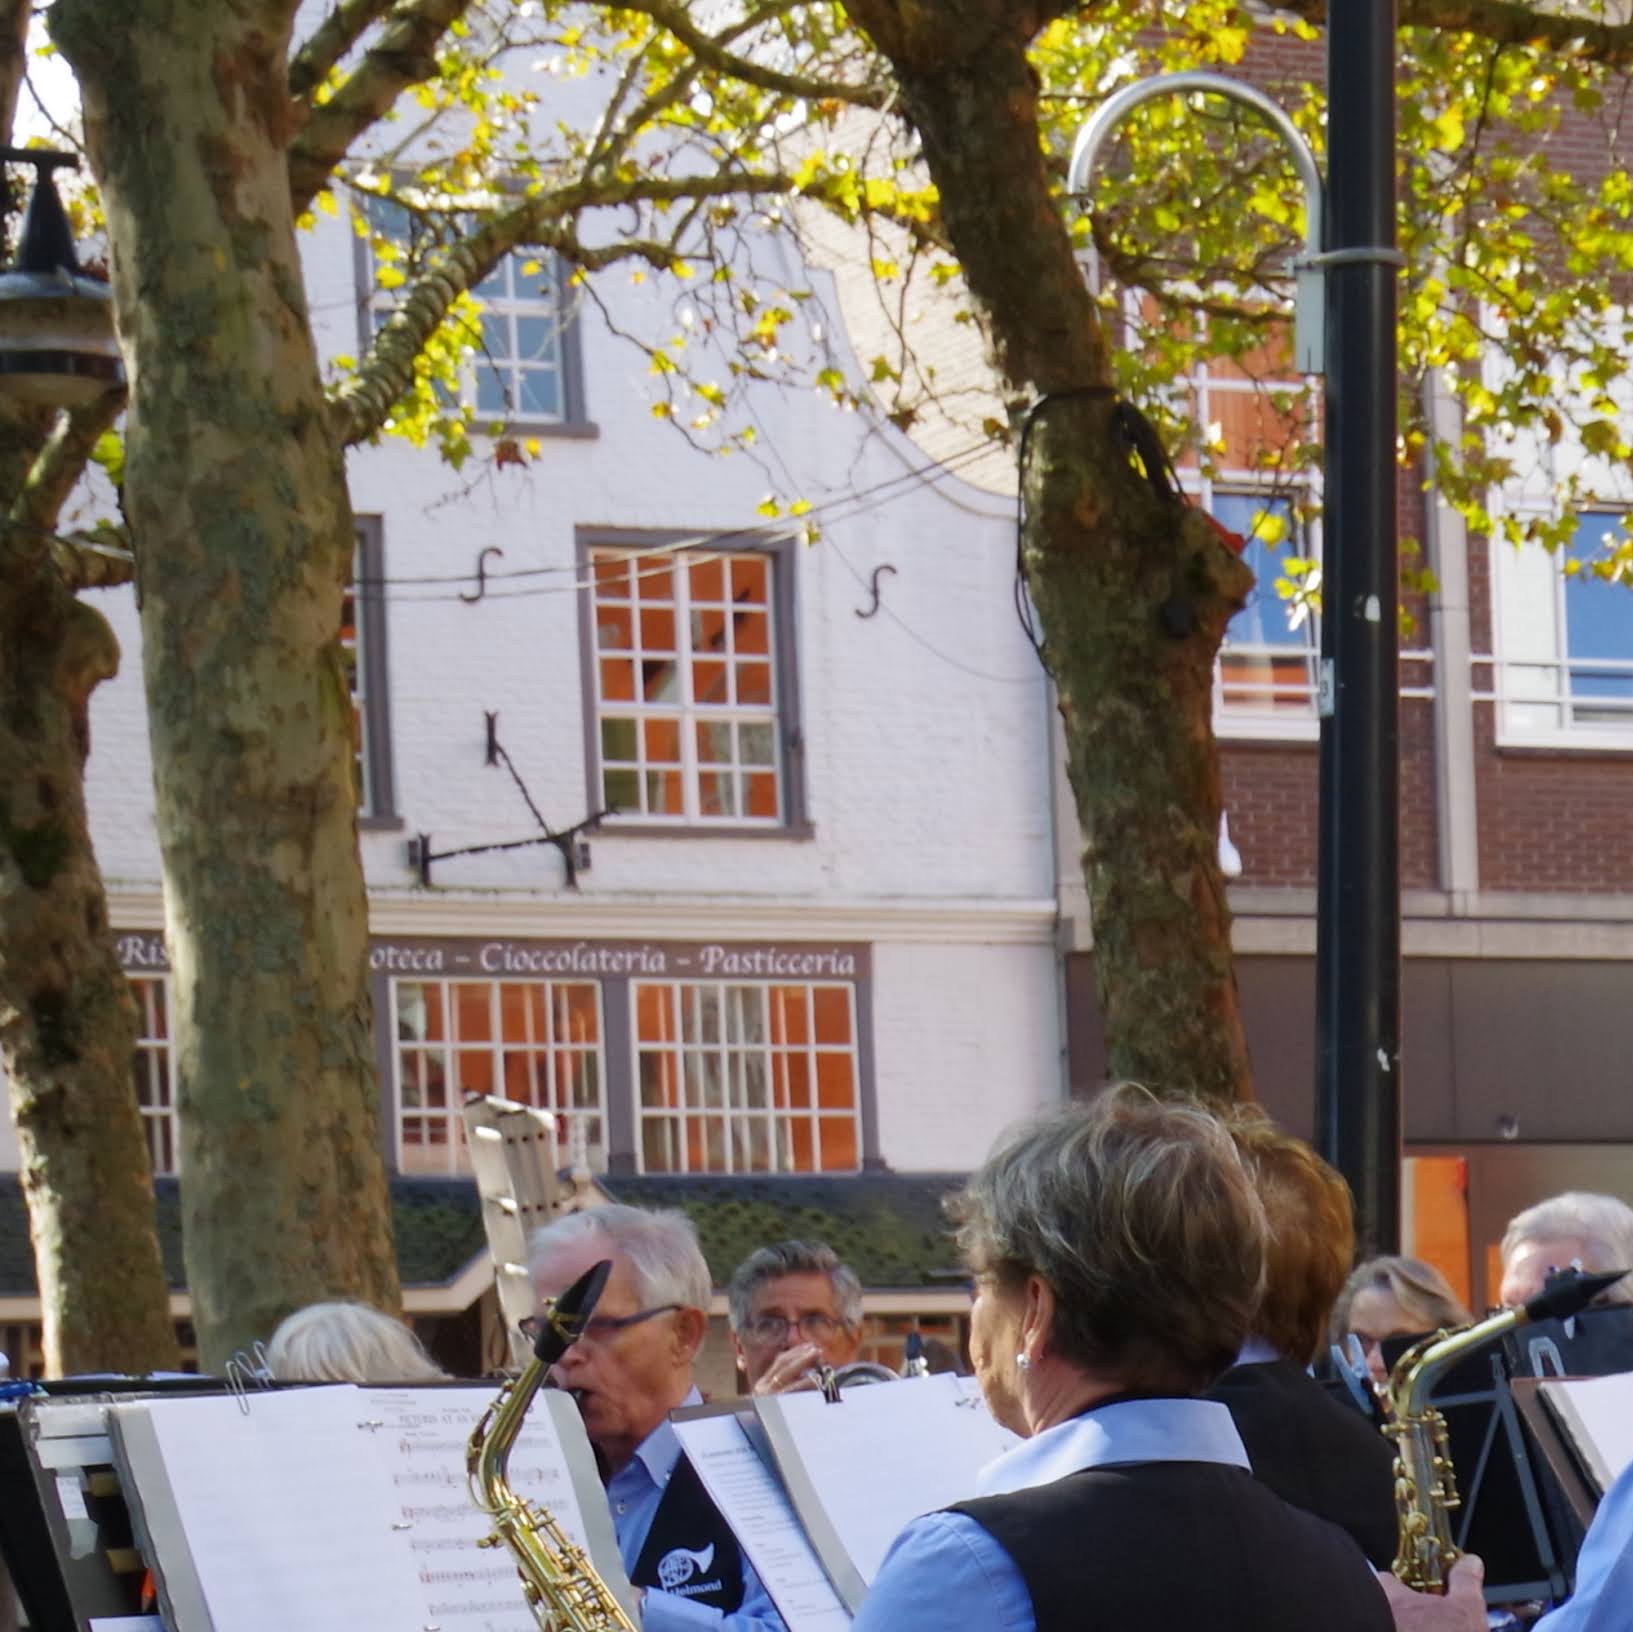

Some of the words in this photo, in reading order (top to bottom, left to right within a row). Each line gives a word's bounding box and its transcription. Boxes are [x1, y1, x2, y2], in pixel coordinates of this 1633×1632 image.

[117, 936, 168, 967] Ris
[369, 944, 443, 970] oteca
[479, 942, 667, 973] Cioccolateria
[701, 945, 855, 975] Pasticceria
